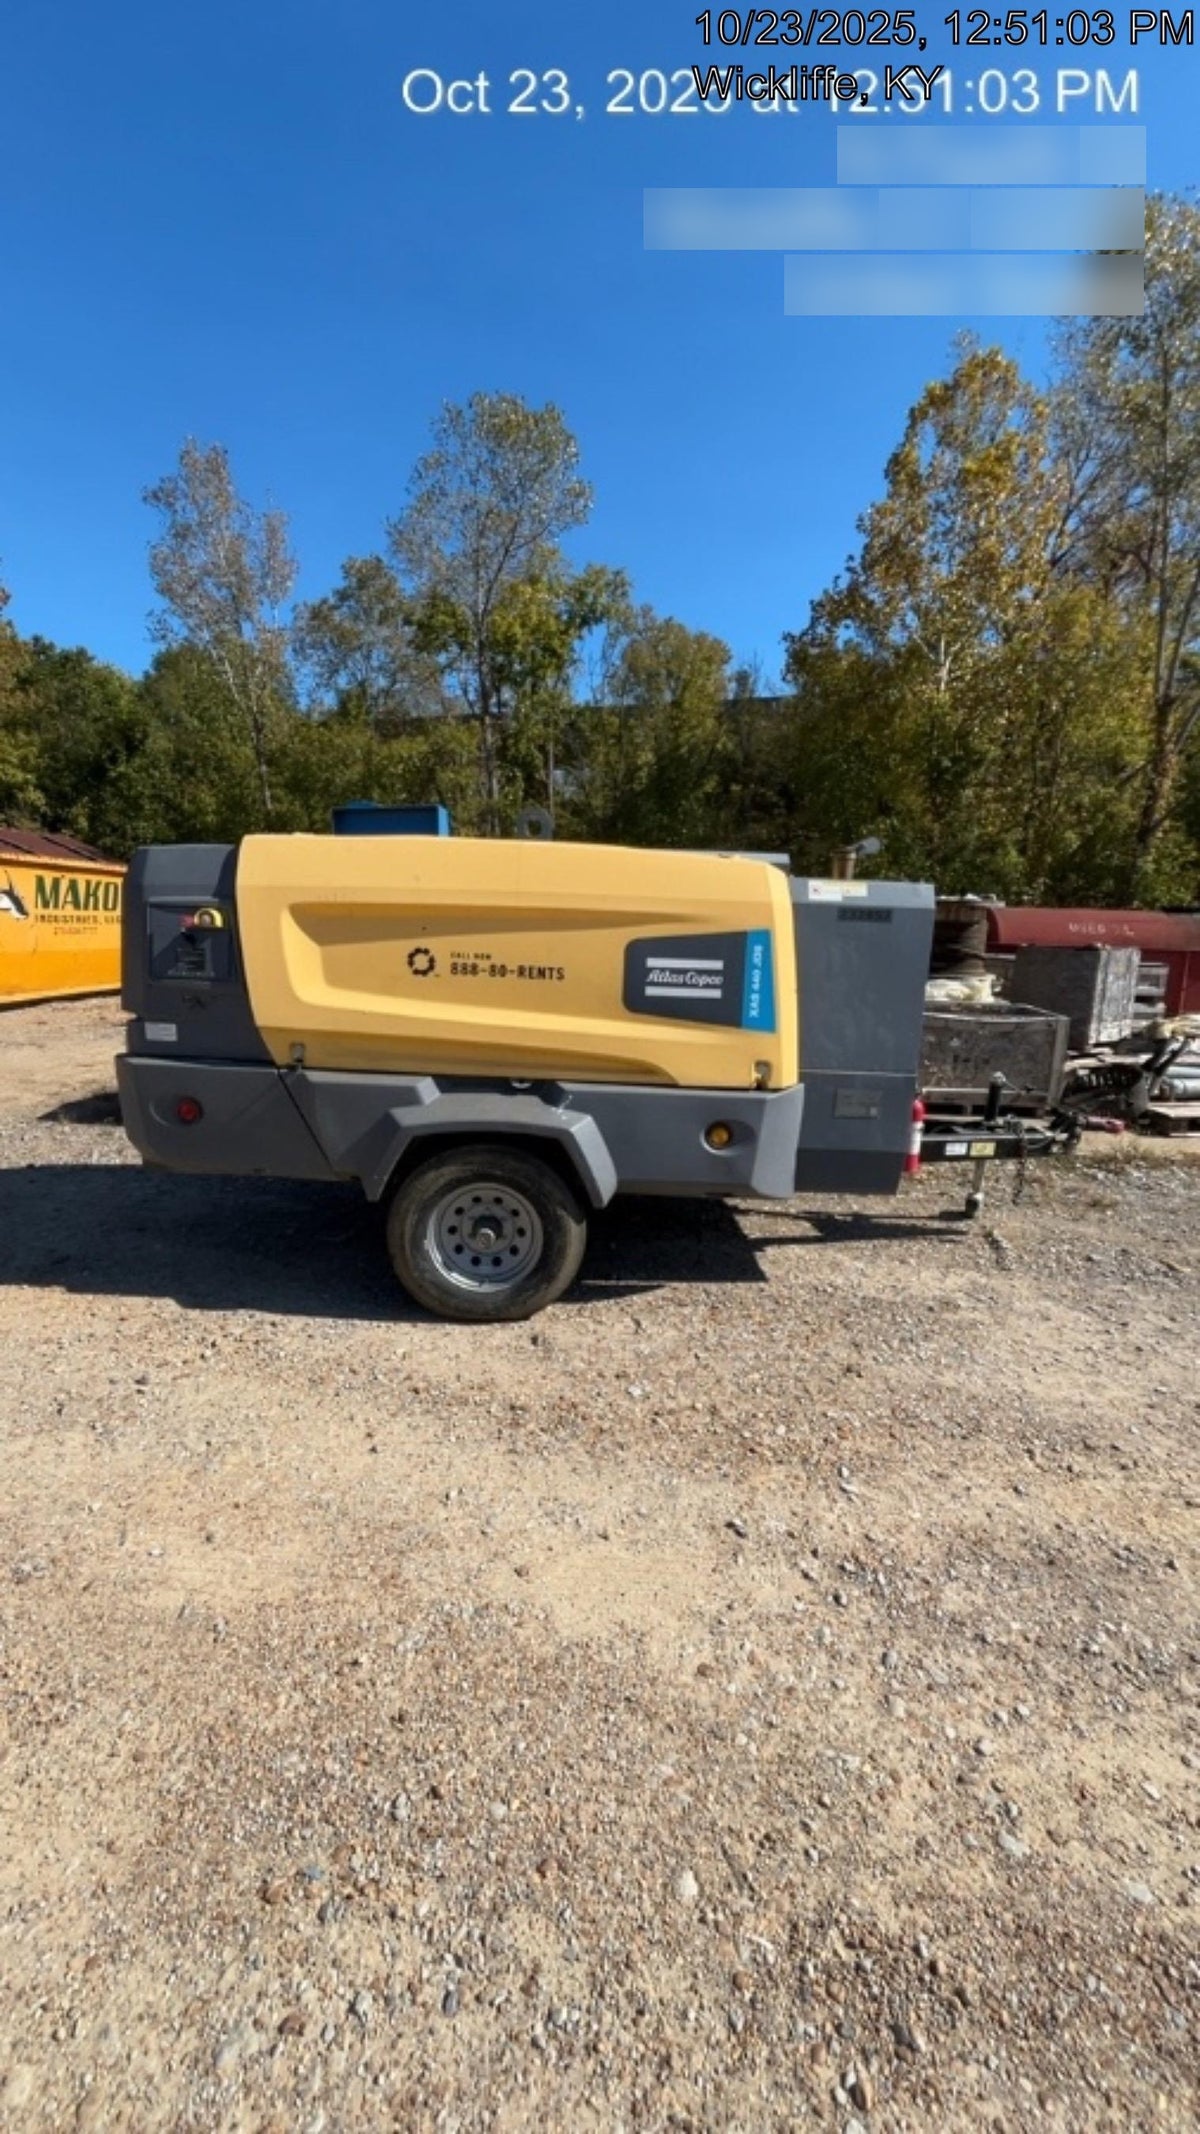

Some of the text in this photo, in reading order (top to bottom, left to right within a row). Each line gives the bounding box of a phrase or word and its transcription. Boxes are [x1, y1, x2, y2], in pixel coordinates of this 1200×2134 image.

[35, 874, 119, 912] MAKO
[450, 962, 565, 981] 888-80-RENTS
[646, 969, 724, 987] Atlas Copco
